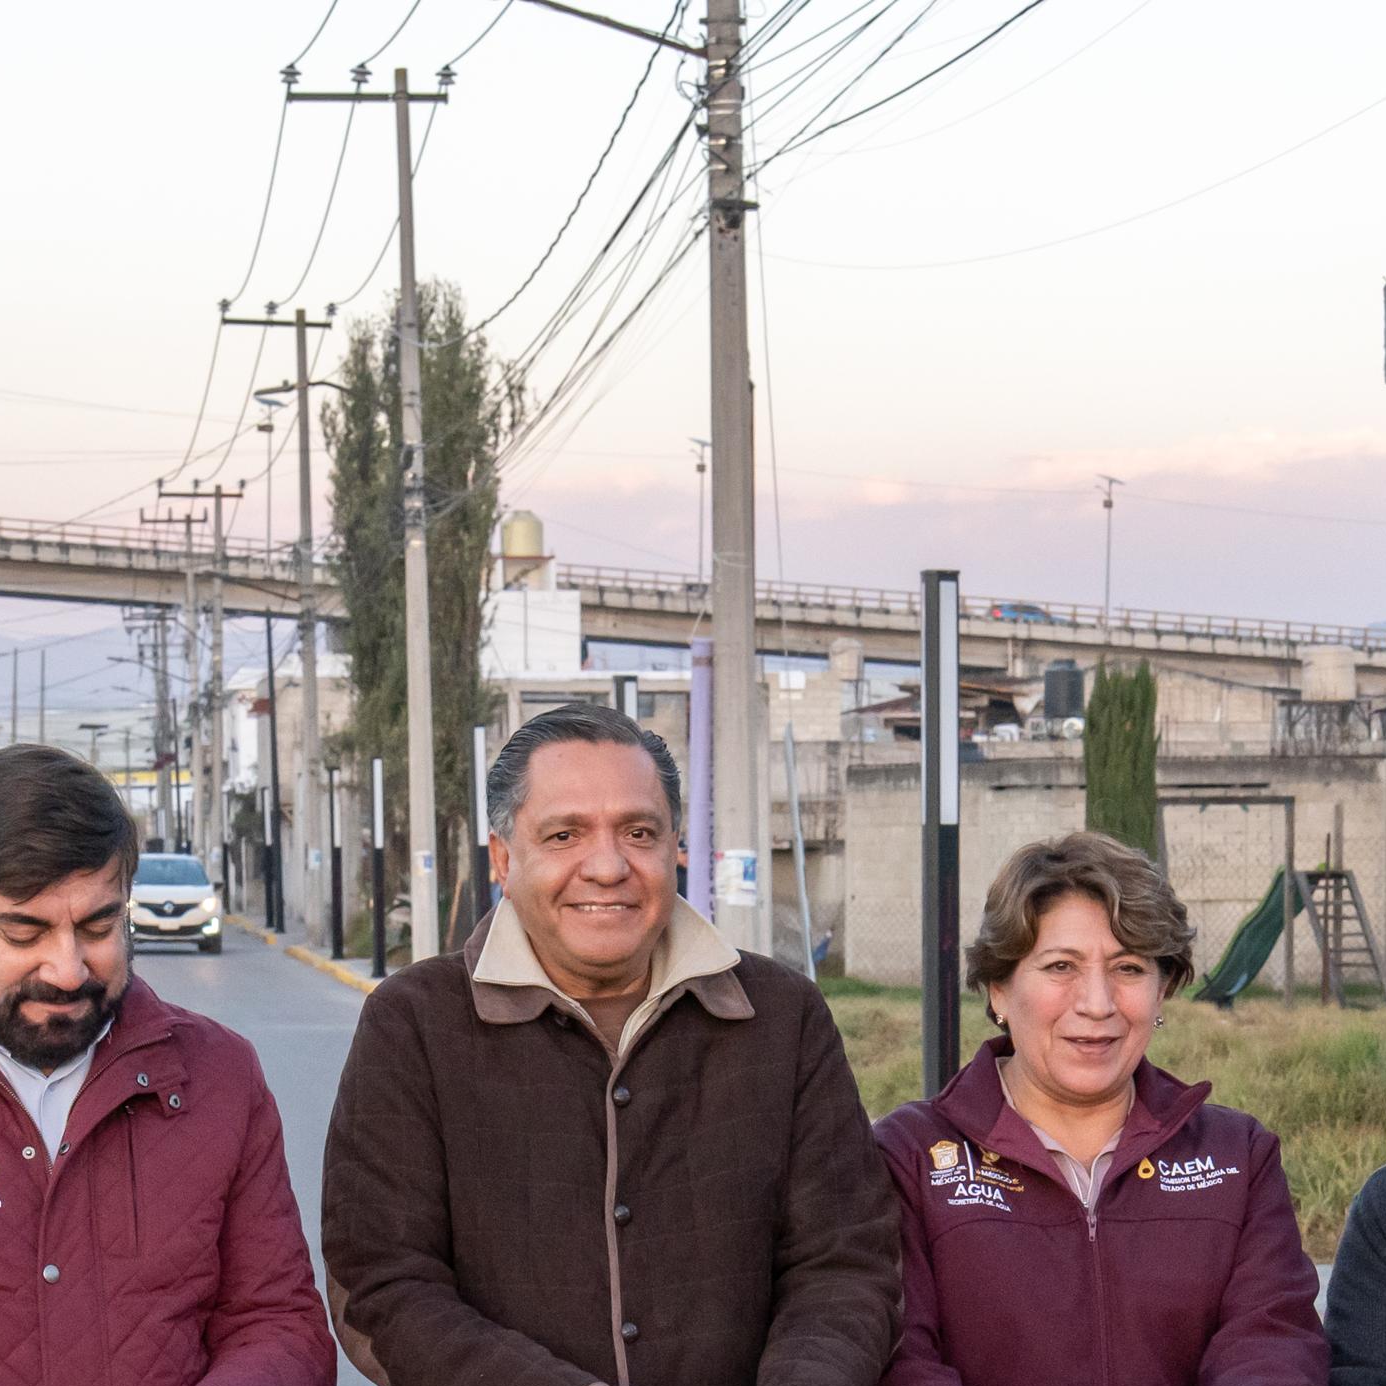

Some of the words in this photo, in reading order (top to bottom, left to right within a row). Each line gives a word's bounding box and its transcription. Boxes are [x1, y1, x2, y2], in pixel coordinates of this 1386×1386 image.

[1158, 1156, 1215, 1176] CAEM
[1192, 1174, 1205, 1182] DEL
[1206, 1169, 1226, 1179] AGUA
[954, 1183, 1004, 1202] AGUA
[1160, 1183, 1185, 1192] ESTADO
